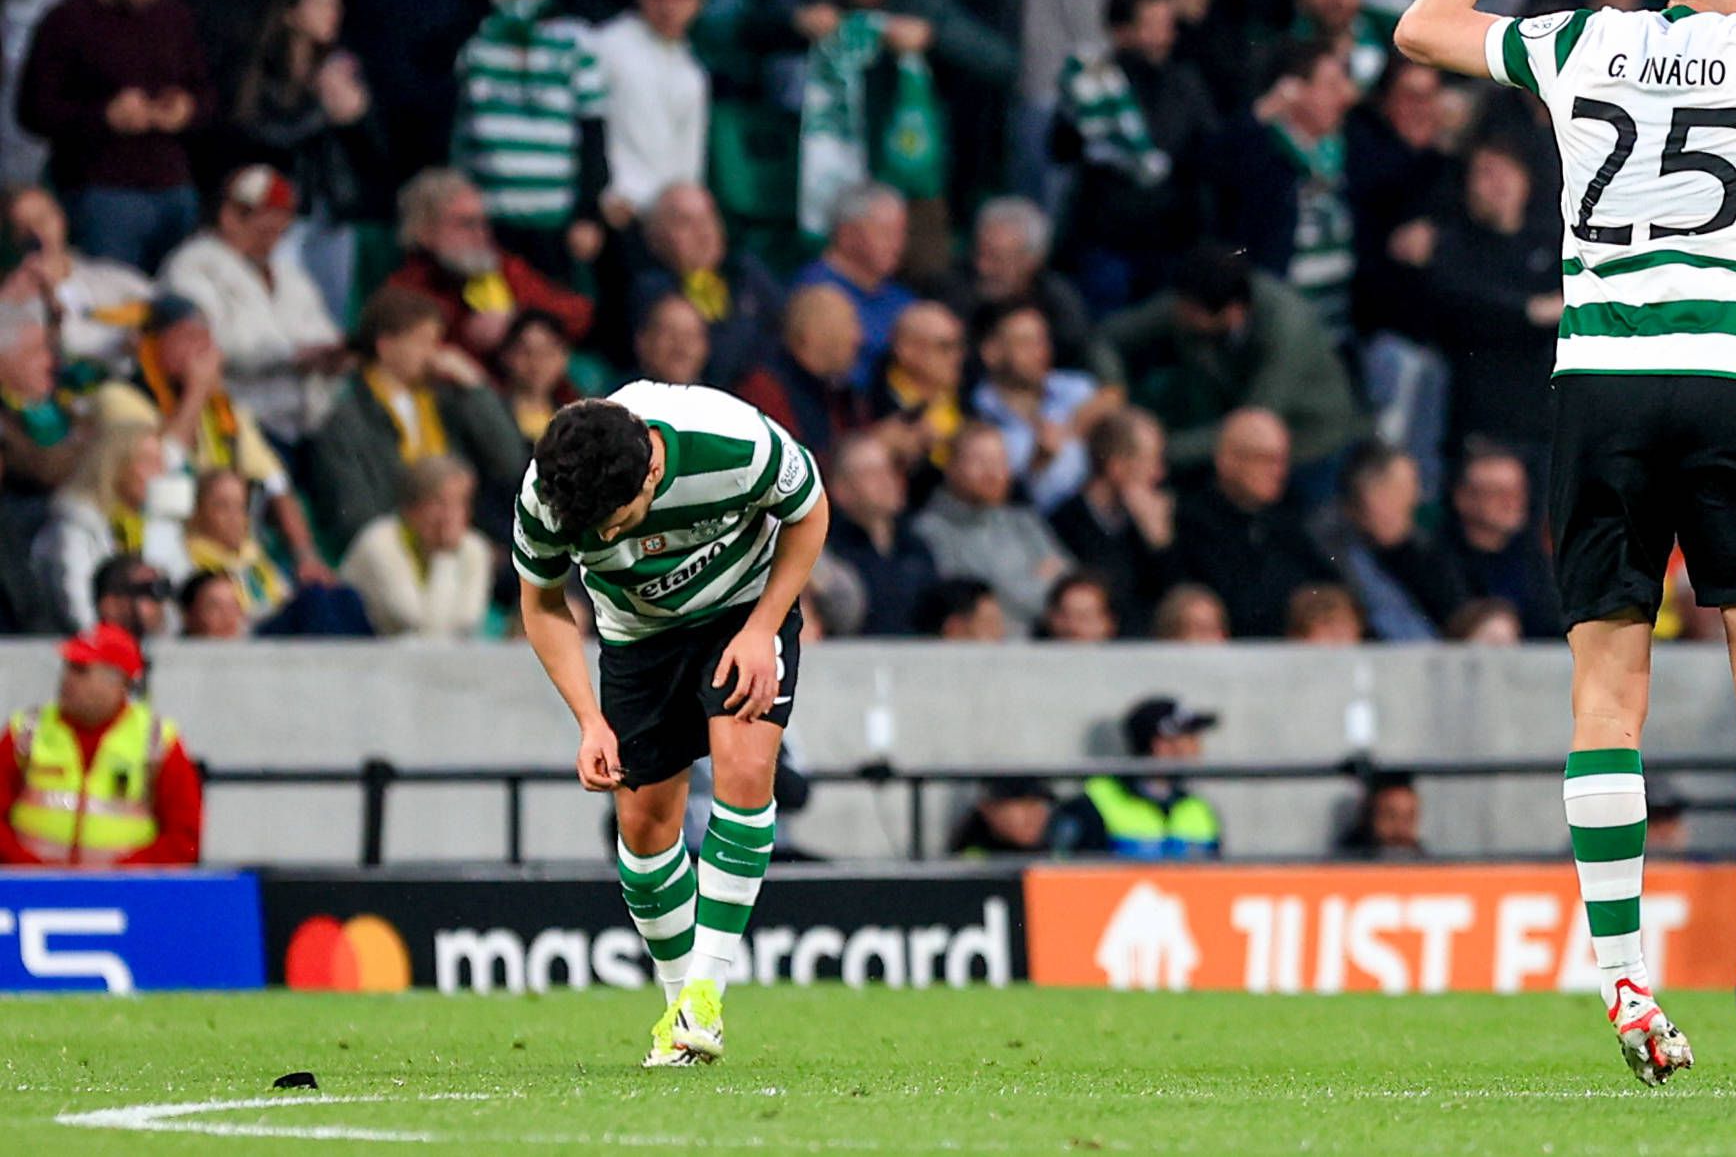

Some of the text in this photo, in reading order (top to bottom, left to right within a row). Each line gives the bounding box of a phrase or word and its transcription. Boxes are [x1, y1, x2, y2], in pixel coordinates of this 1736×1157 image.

[1607, 53, 1628, 79] G.
[626, 541, 727, 599] etano
[434, 896, 1013, 994] masrcard
[1230, 894, 1475, 994] JUST
